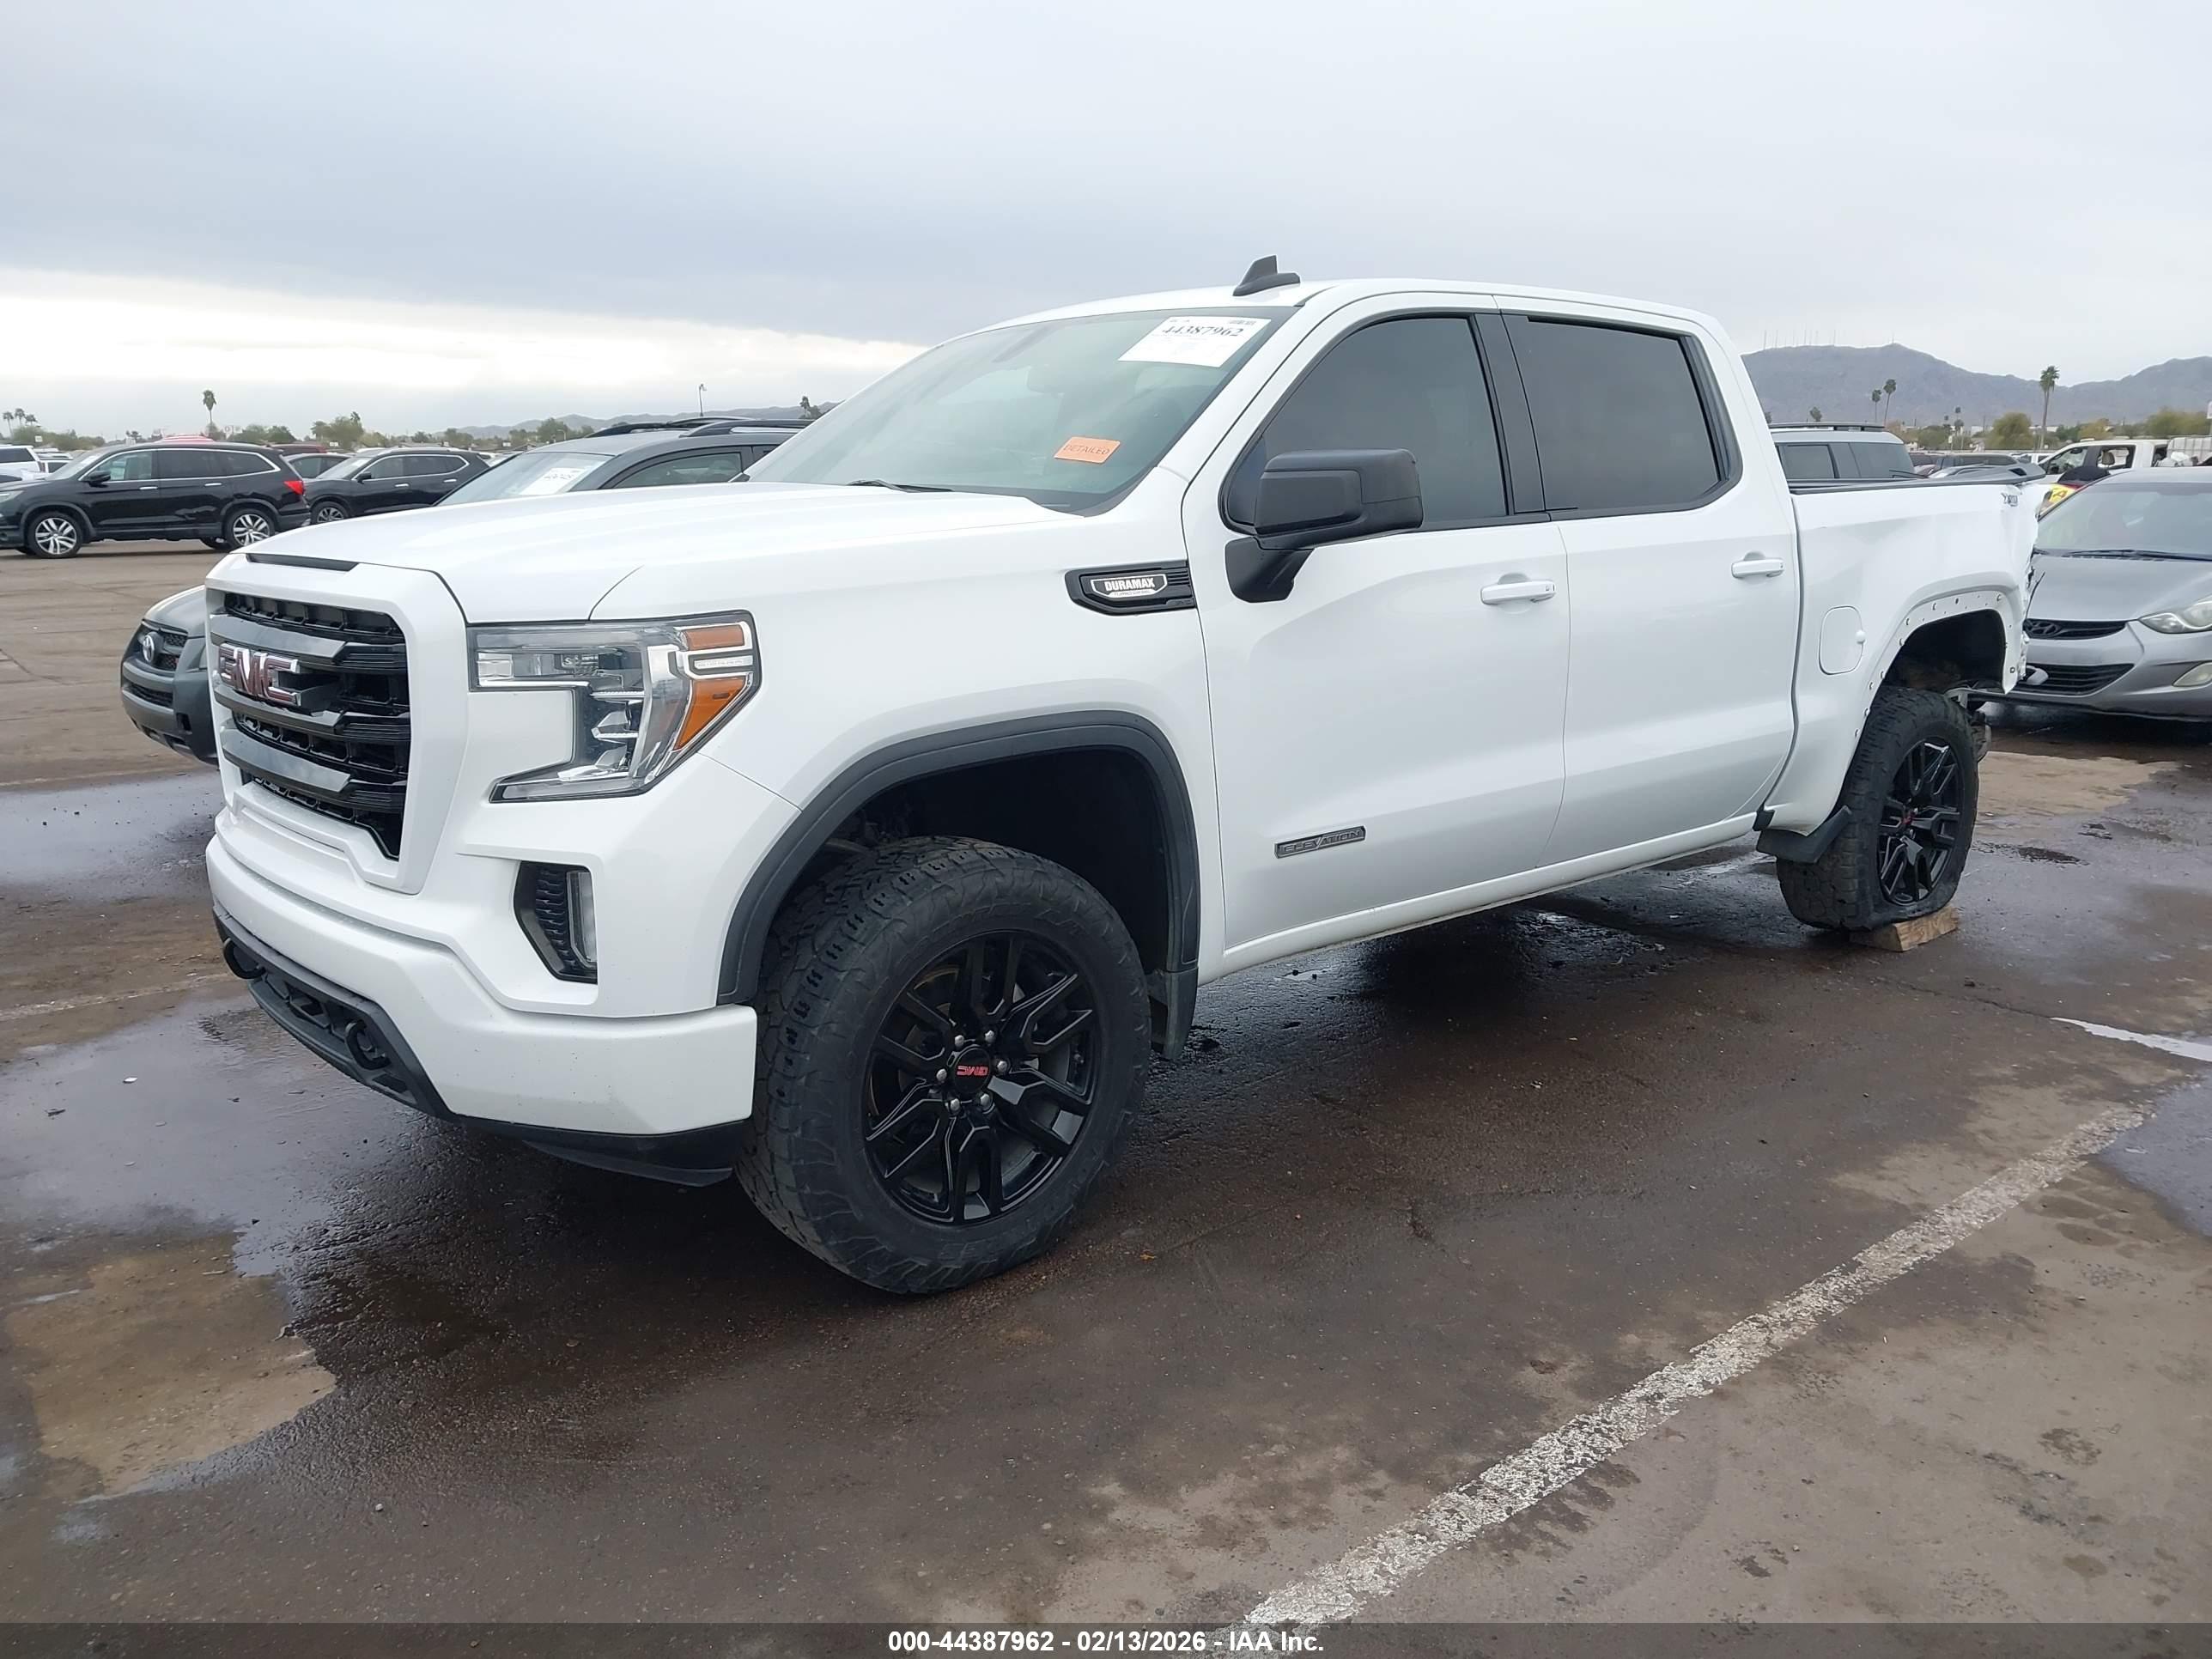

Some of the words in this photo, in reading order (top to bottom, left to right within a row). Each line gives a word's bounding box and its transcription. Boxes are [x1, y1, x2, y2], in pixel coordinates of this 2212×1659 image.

[1162, 325, 1244, 337] 44387962
[1104, 577, 1156, 592] DURAMAX
[218, 642, 301, 707] GMC
[957, 1065, 988, 1077] GMC
